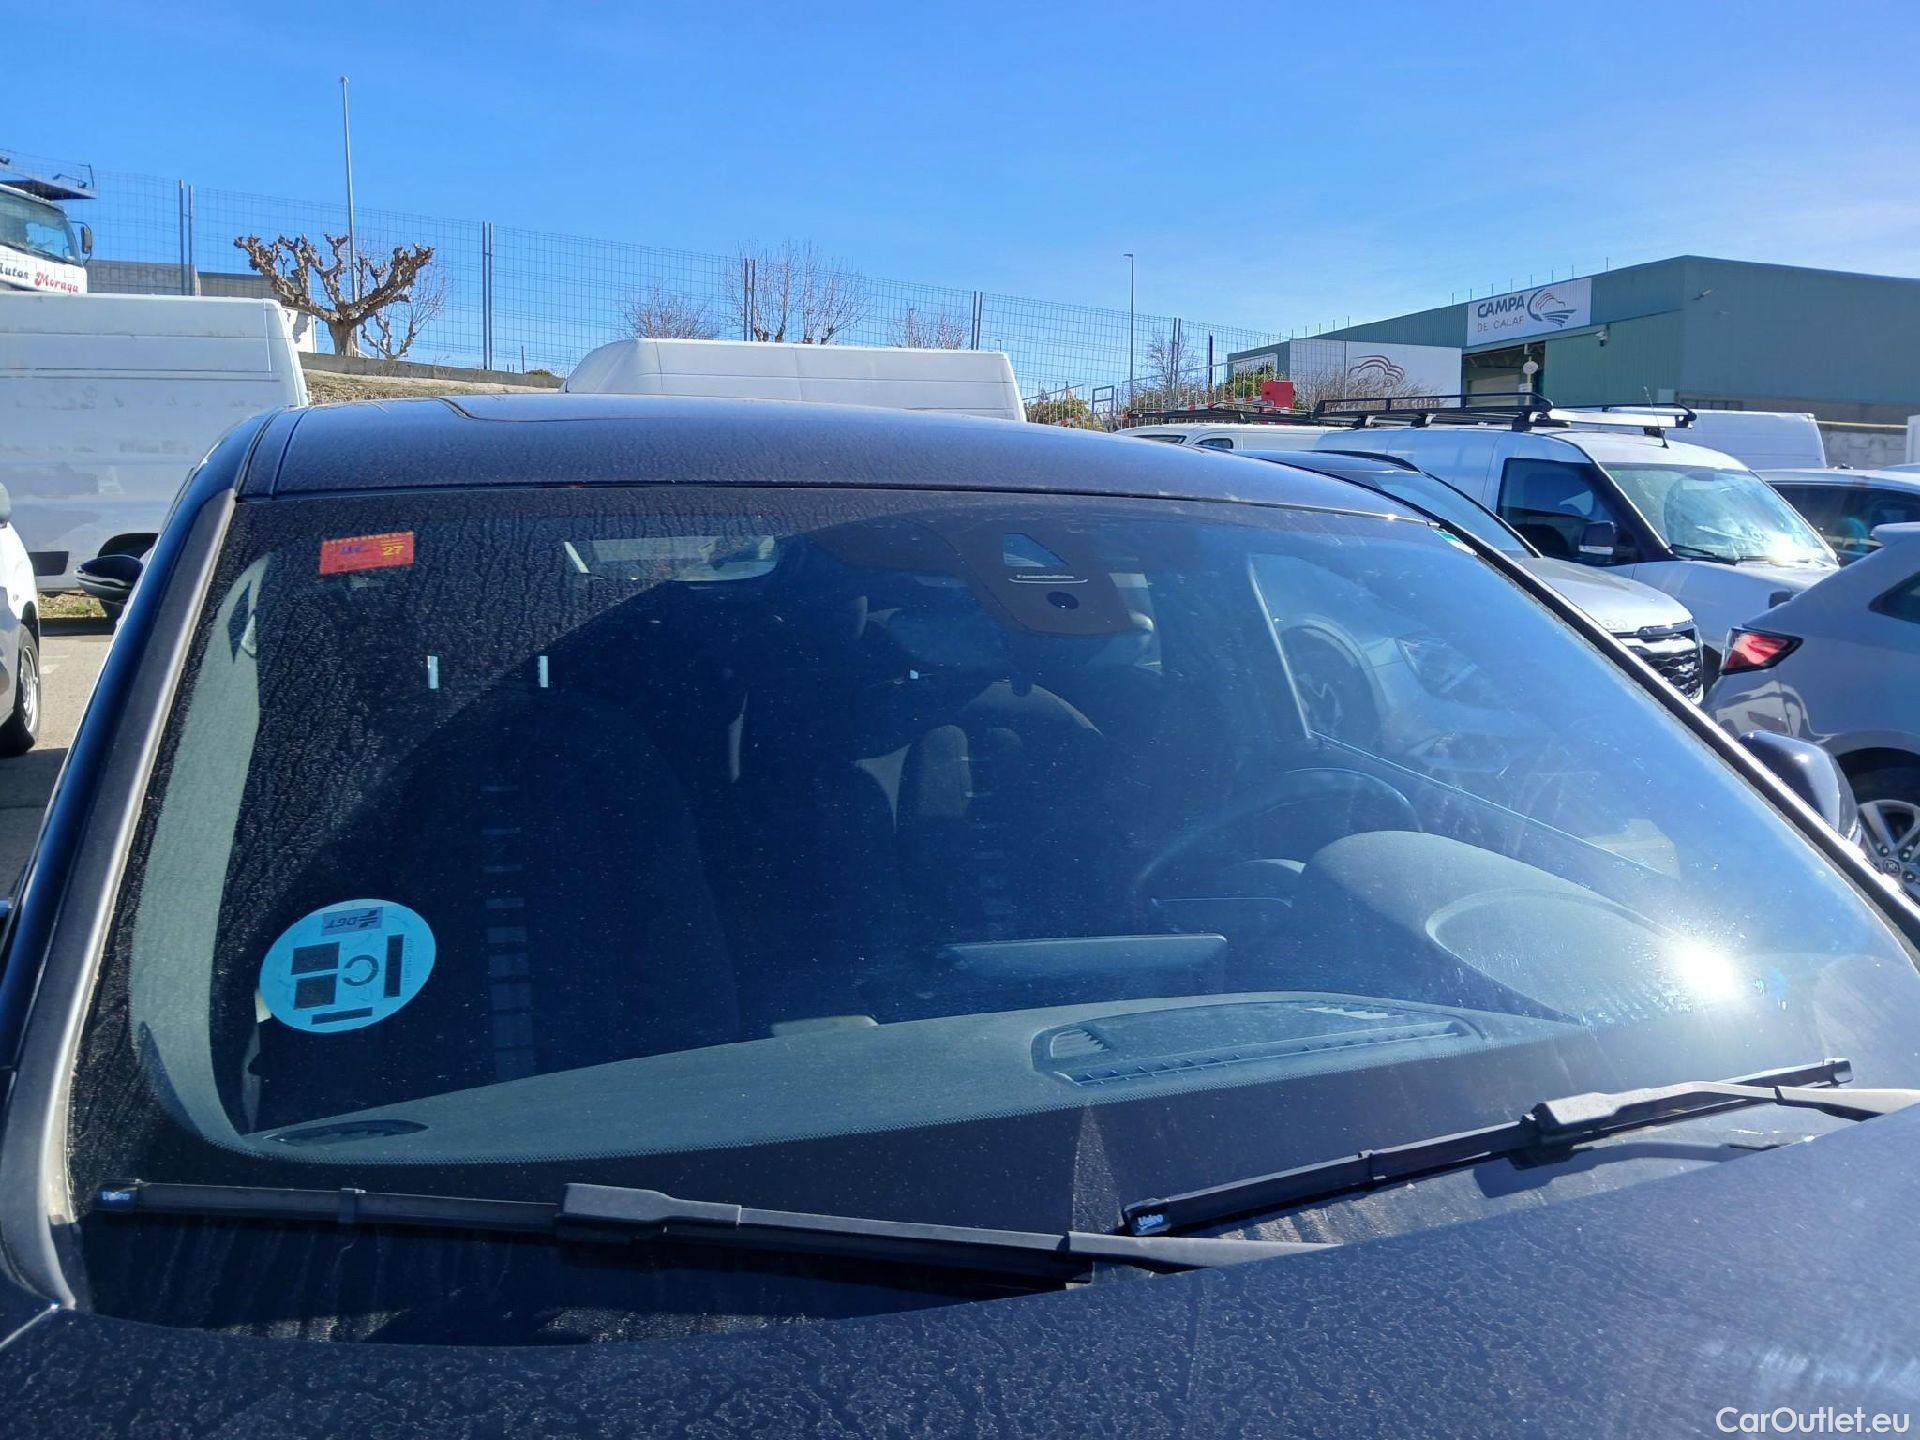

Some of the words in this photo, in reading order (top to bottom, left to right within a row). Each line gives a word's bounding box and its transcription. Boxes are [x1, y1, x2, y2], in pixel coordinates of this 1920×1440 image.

[1477, 295, 1525, 318] CAMPA
[1477, 321, 1488, 332] DE
[1494, 315, 1524, 329] CALAF
[325, 916, 359, 929] DGT
